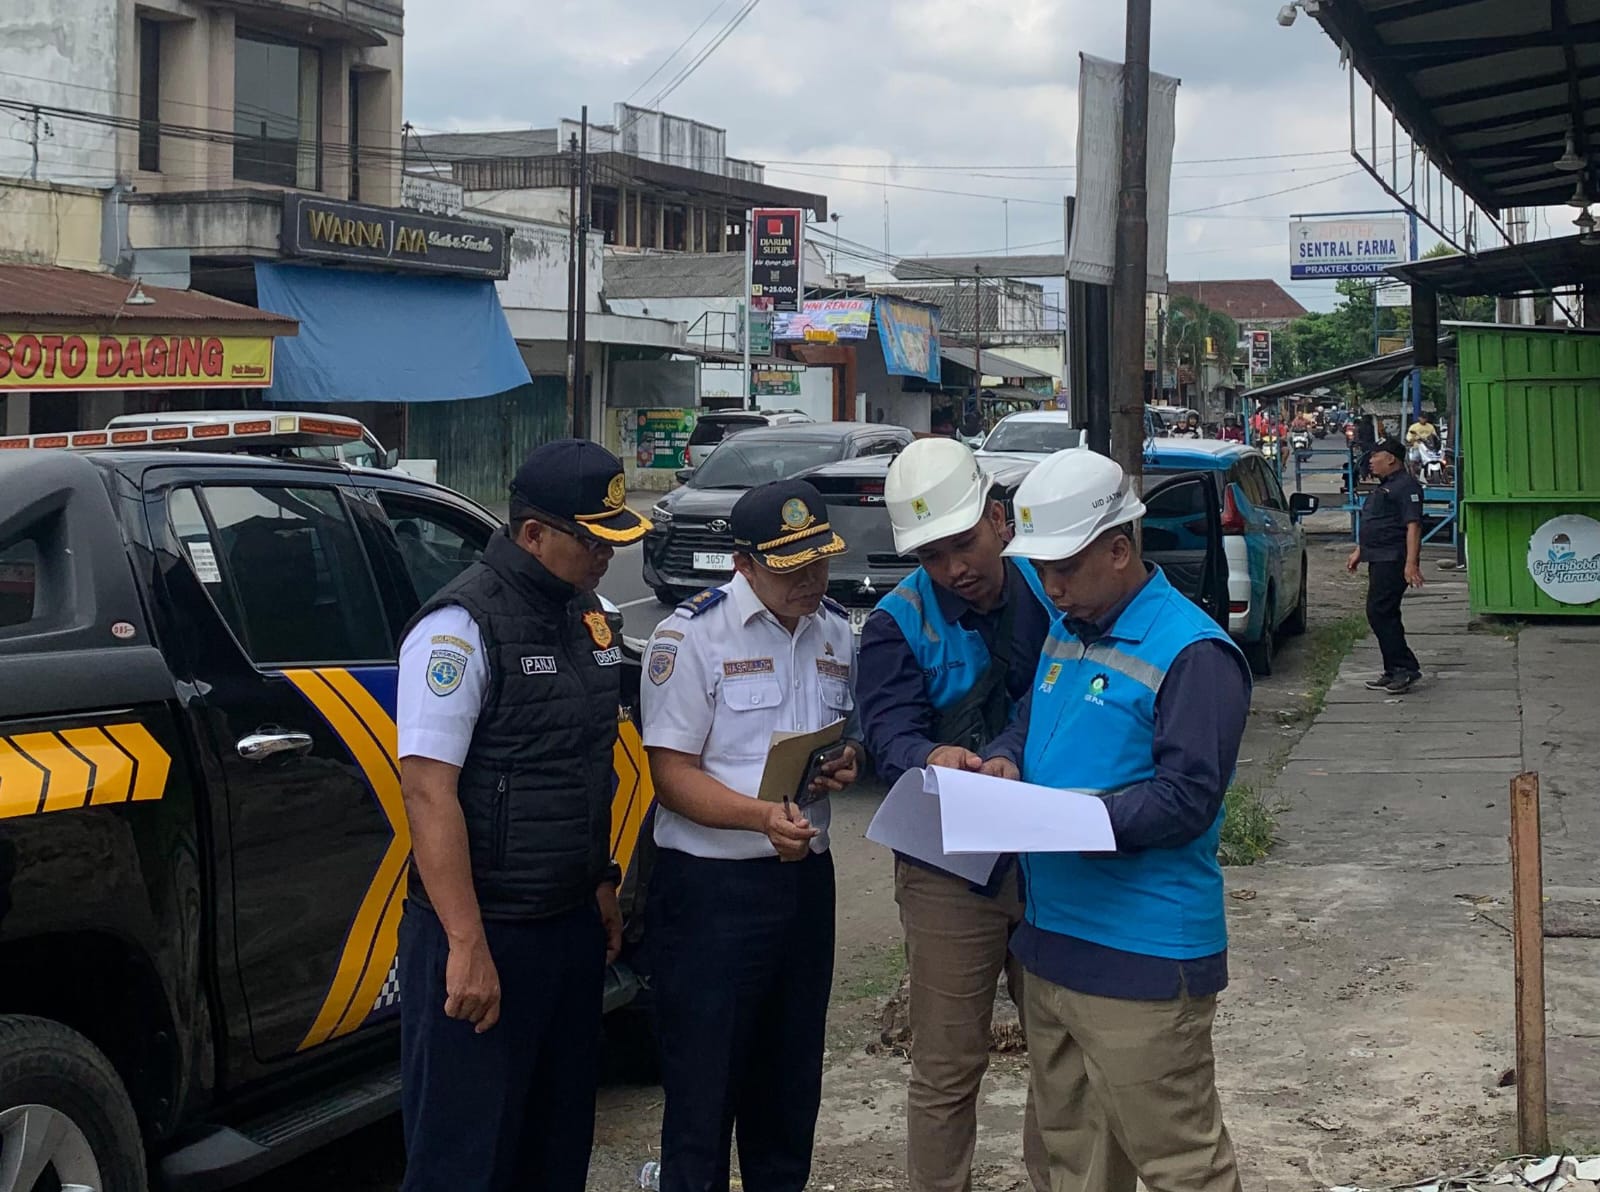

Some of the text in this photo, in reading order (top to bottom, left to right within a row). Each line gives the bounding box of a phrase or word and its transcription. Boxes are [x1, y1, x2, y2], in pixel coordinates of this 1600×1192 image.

[309, 209, 385, 248] WARNA
[387, 220, 428, 257] JAYA
[760, 238, 792, 246] DJARUM
[1299, 239, 1397, 258] SENTRAL FARMA
[763, 246, 788, 254] SUPER
[1305, 264, 1349, 274] PRAKTEK
[96, 335, 224, 378] DAGING
[525, 658, 554, 671] PANJI
